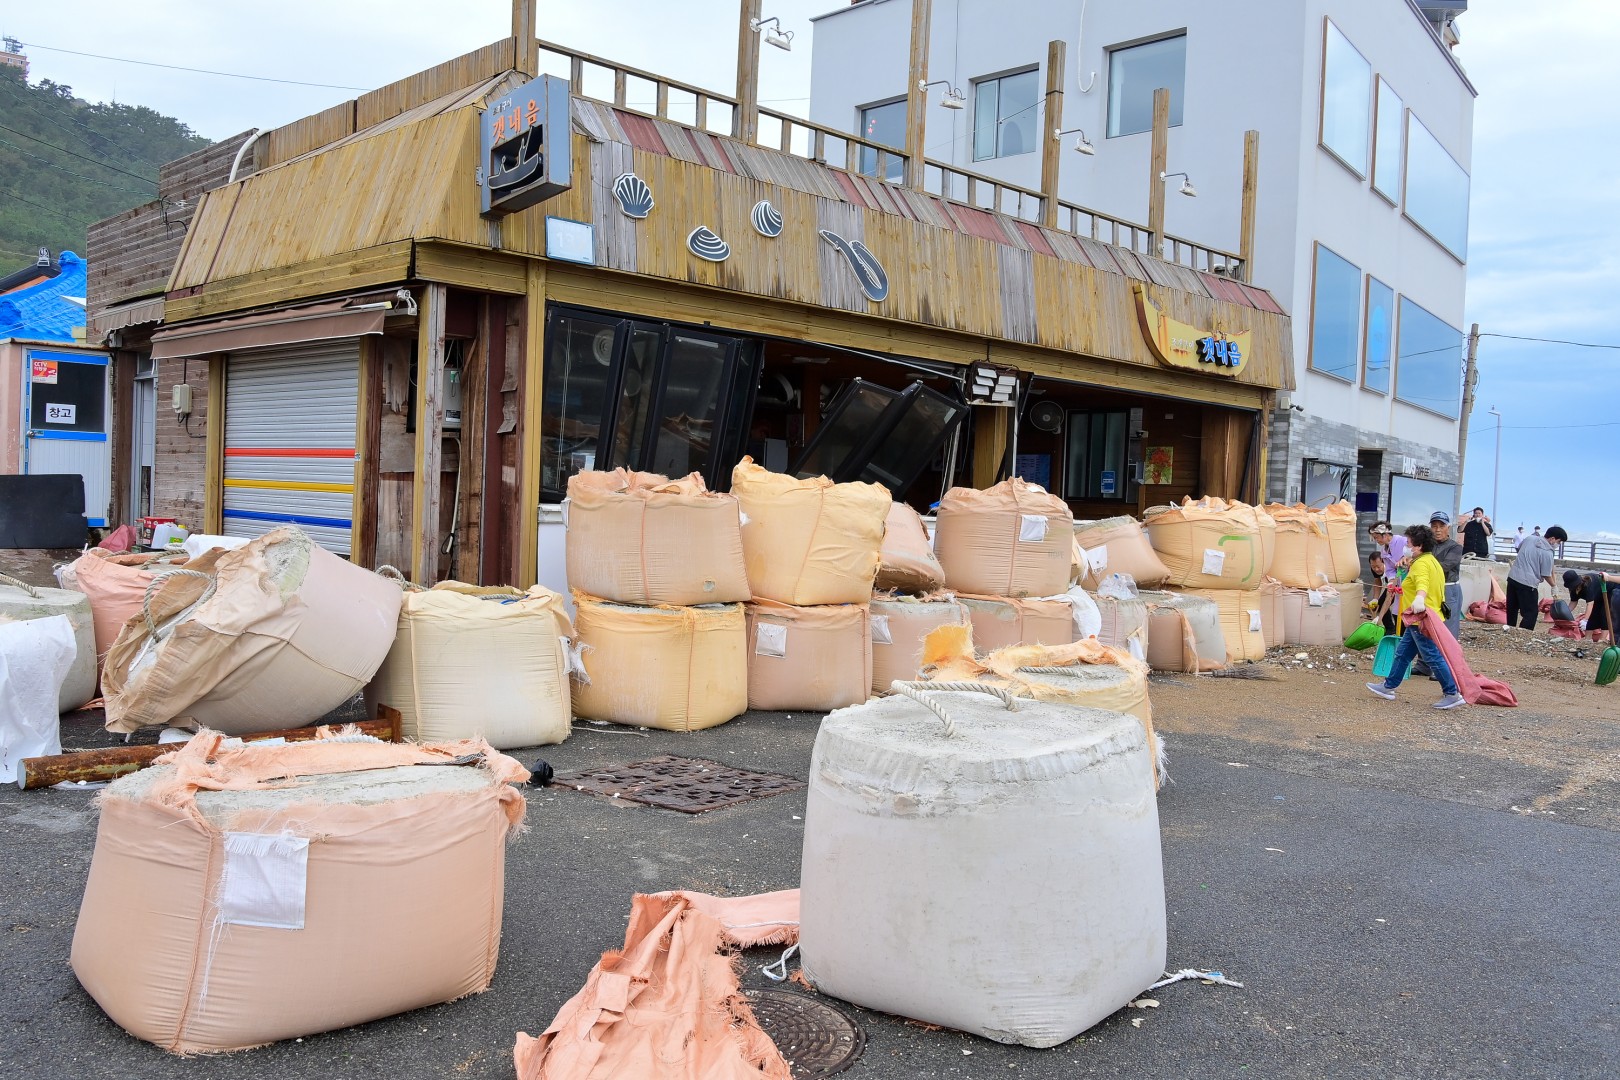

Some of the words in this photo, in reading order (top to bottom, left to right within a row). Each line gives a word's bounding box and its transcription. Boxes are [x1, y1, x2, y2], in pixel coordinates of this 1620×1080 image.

[492, 99, 541, 145] 갯내음
[1202, 336, 1242, 367] 갯내음
[49, 407, 72, 418] 창고
